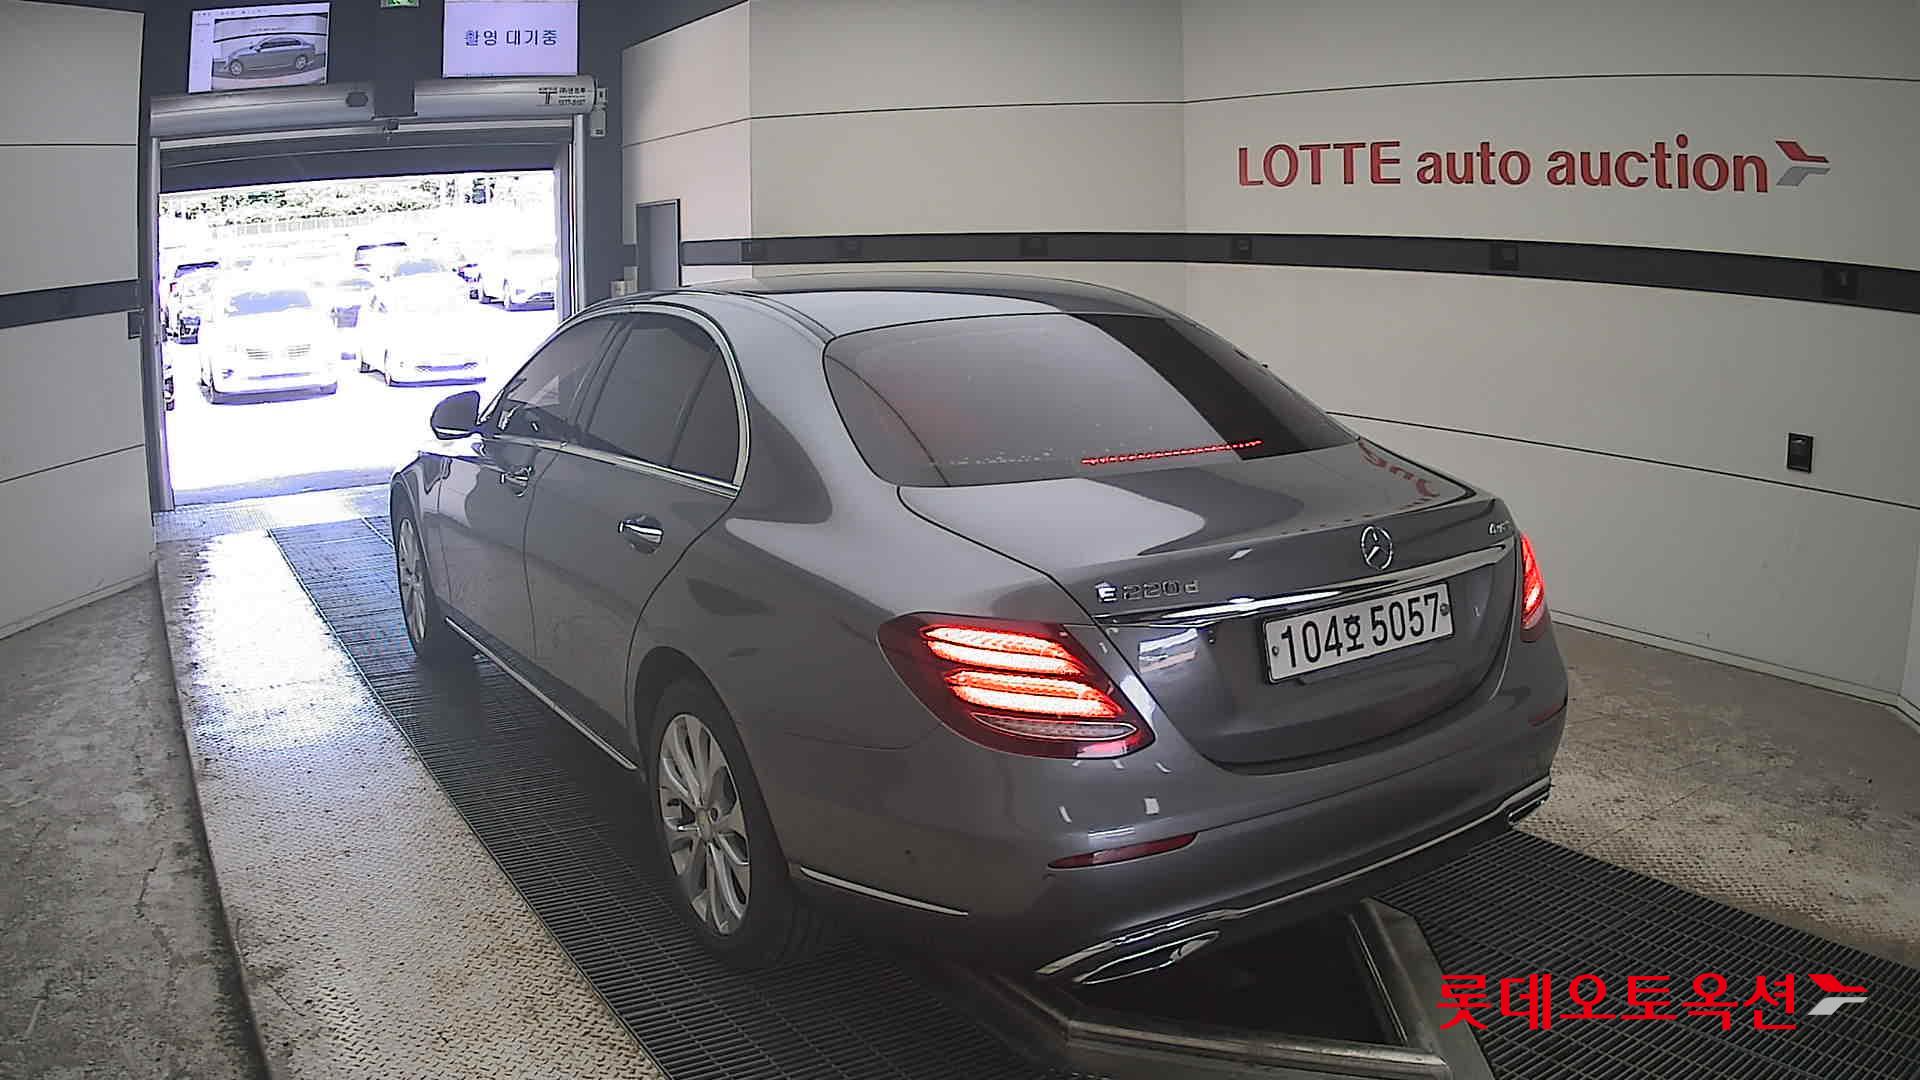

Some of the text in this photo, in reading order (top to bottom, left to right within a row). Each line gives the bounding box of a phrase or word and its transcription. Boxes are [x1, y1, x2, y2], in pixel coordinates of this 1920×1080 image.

[506, 29, 557, 46] 대기중
[1237, 133, 1769, 194] LOTTE auto auction
[1370, 592, 1440, 647] 5057
